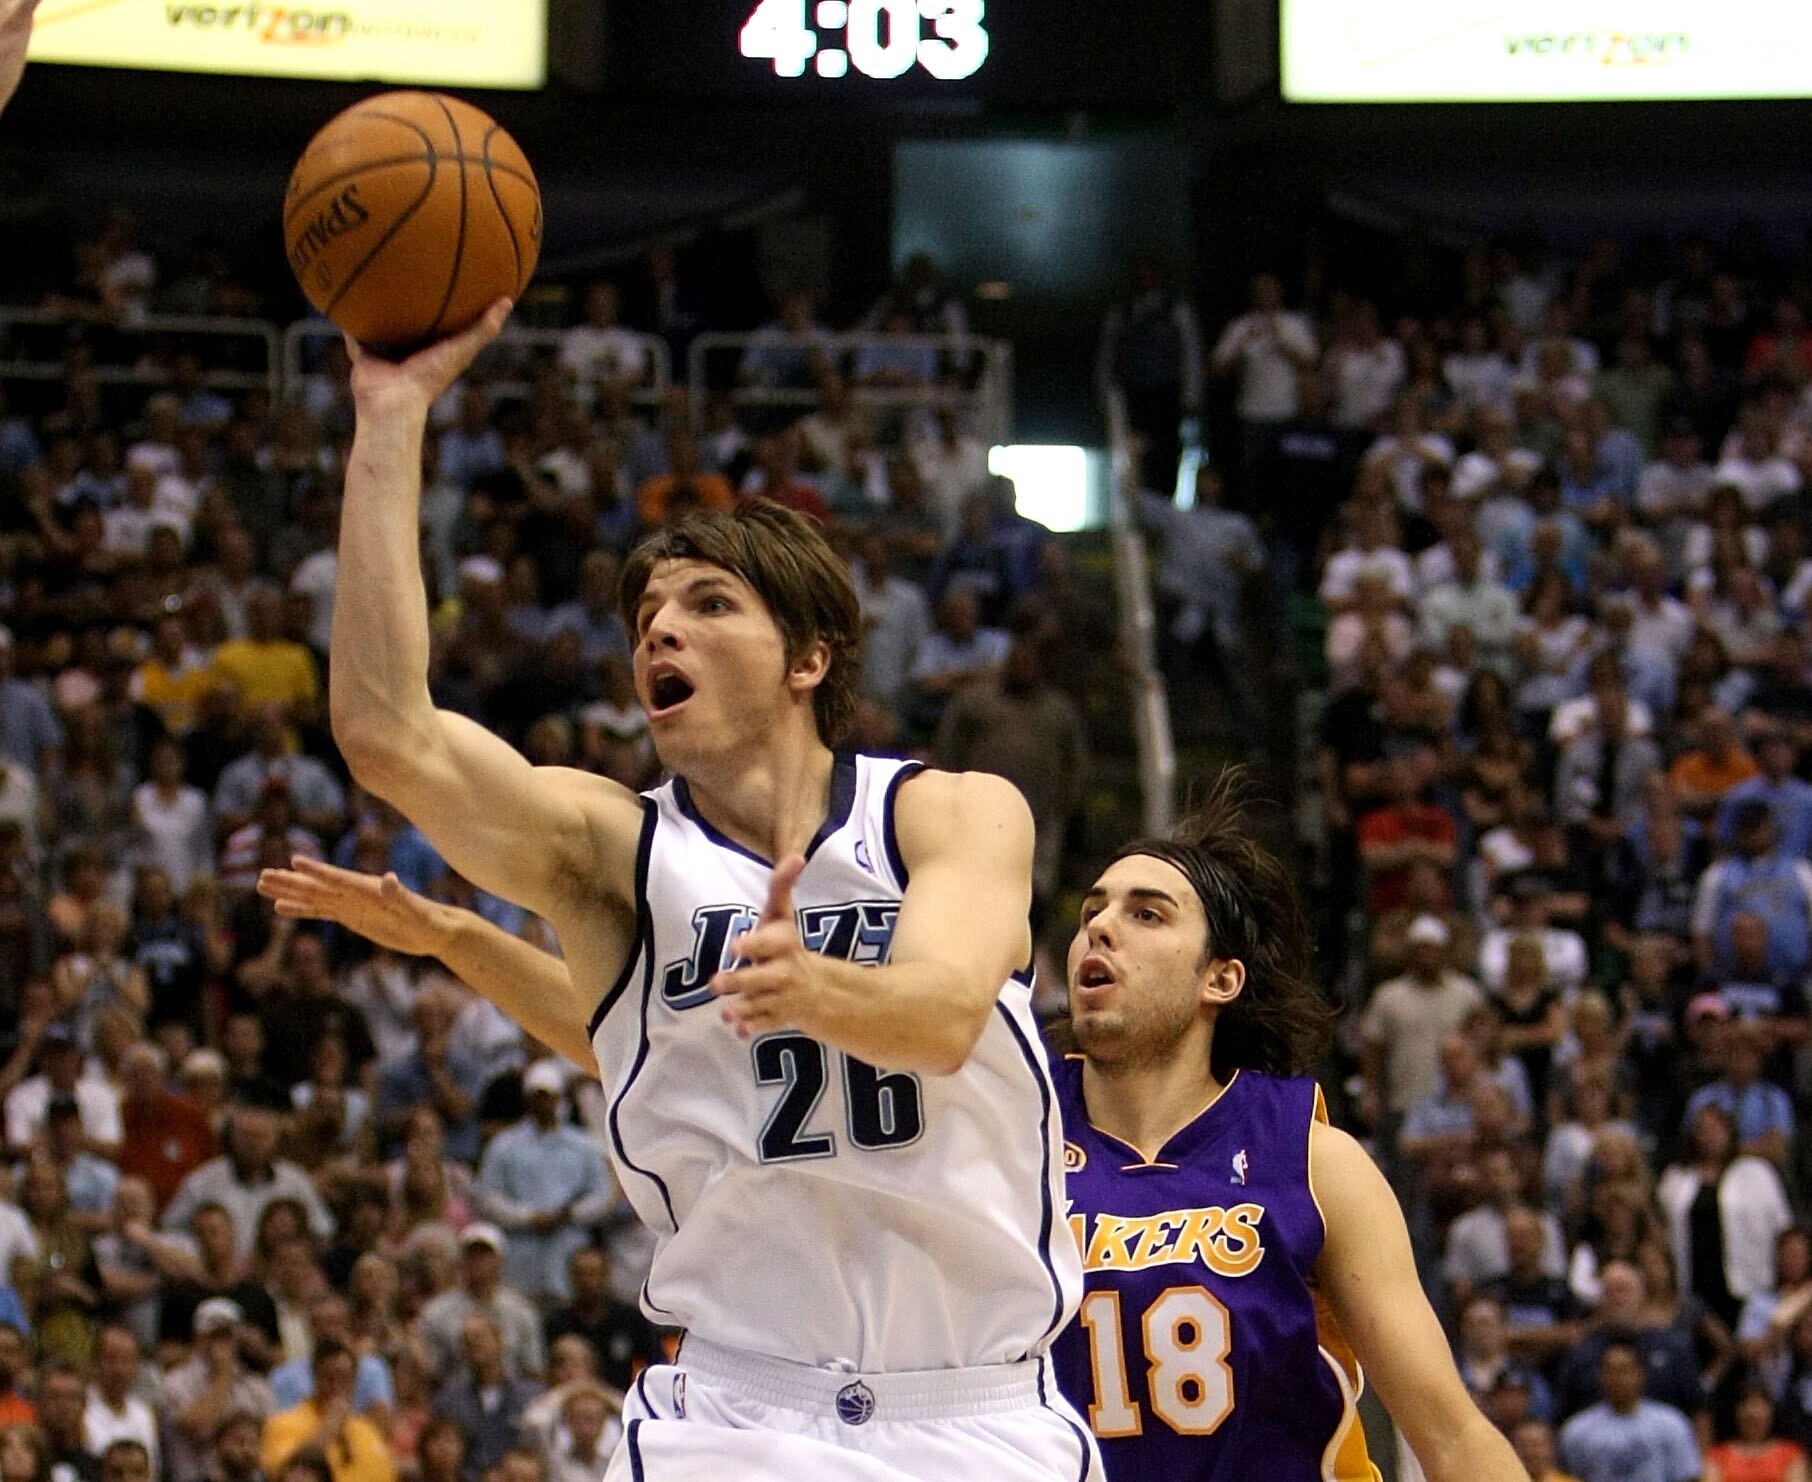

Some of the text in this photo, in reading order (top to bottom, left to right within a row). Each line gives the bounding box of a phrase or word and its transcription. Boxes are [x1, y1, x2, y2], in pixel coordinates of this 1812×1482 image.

[166, 1, 353, 45] verizon
[740, 0, 989, 79] 4:03
[1504, 32, 1691, 66] verizon
[750, 1029, 925, 1165] 26
[1066, 1202, 1265, 1277] KERS
[1080, 1285, 1235, 1438] 18
